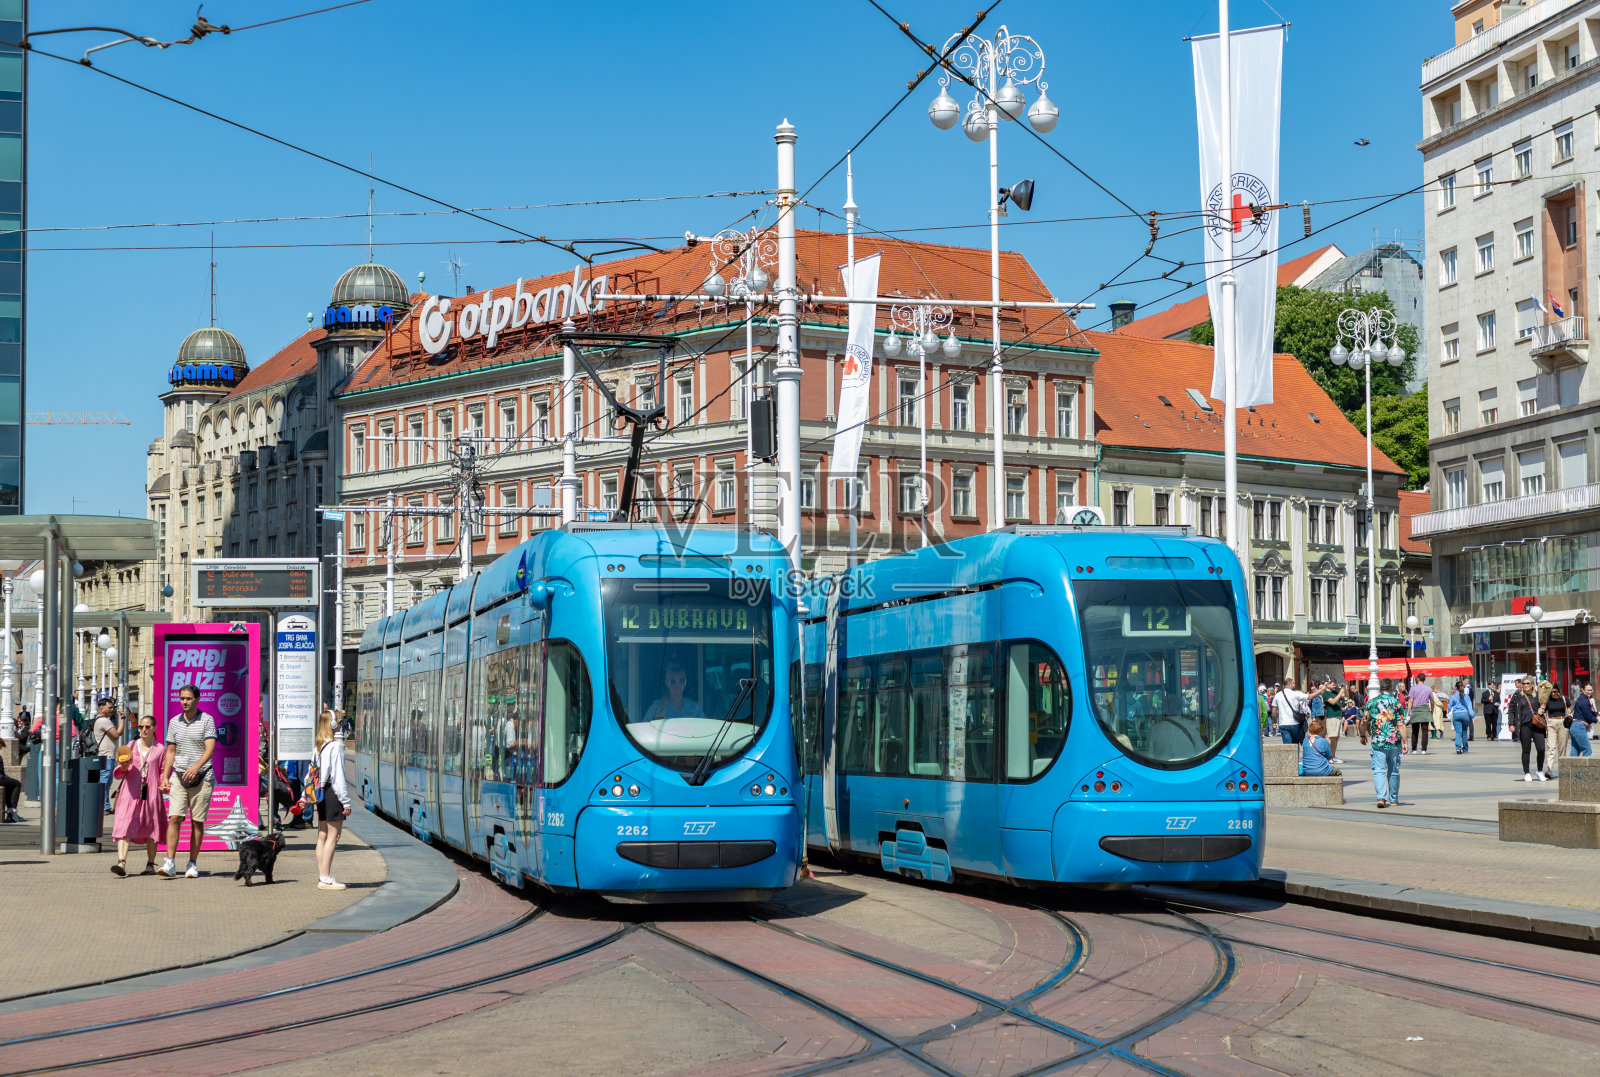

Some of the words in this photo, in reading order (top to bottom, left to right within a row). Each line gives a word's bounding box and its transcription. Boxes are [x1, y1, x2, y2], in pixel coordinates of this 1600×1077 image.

[1231, 175, 1267, 202] CRVENI
[326, 304, 394, 326] nama
[172, 363, 234, 381] nama
[619, 605, 640, 629] 12
[649, 608, 747, 629] DUBRAVA
[1142, 606, 1169, 629] 12
[278, 642, 294, 650] JOSIPA
[285, 634, 295, 642] TRG
[296, 634, 308, 642] BANA
[171, 649, 228, 667] PRIĐI
[547, 812, 565, 827] 2262
[617, 825, 649, 836] 2262
[683, 821, 717, 835] ZET
[1166, 816, 1197, 830] ZET
[1227, 819, 1253, 829] 2268
